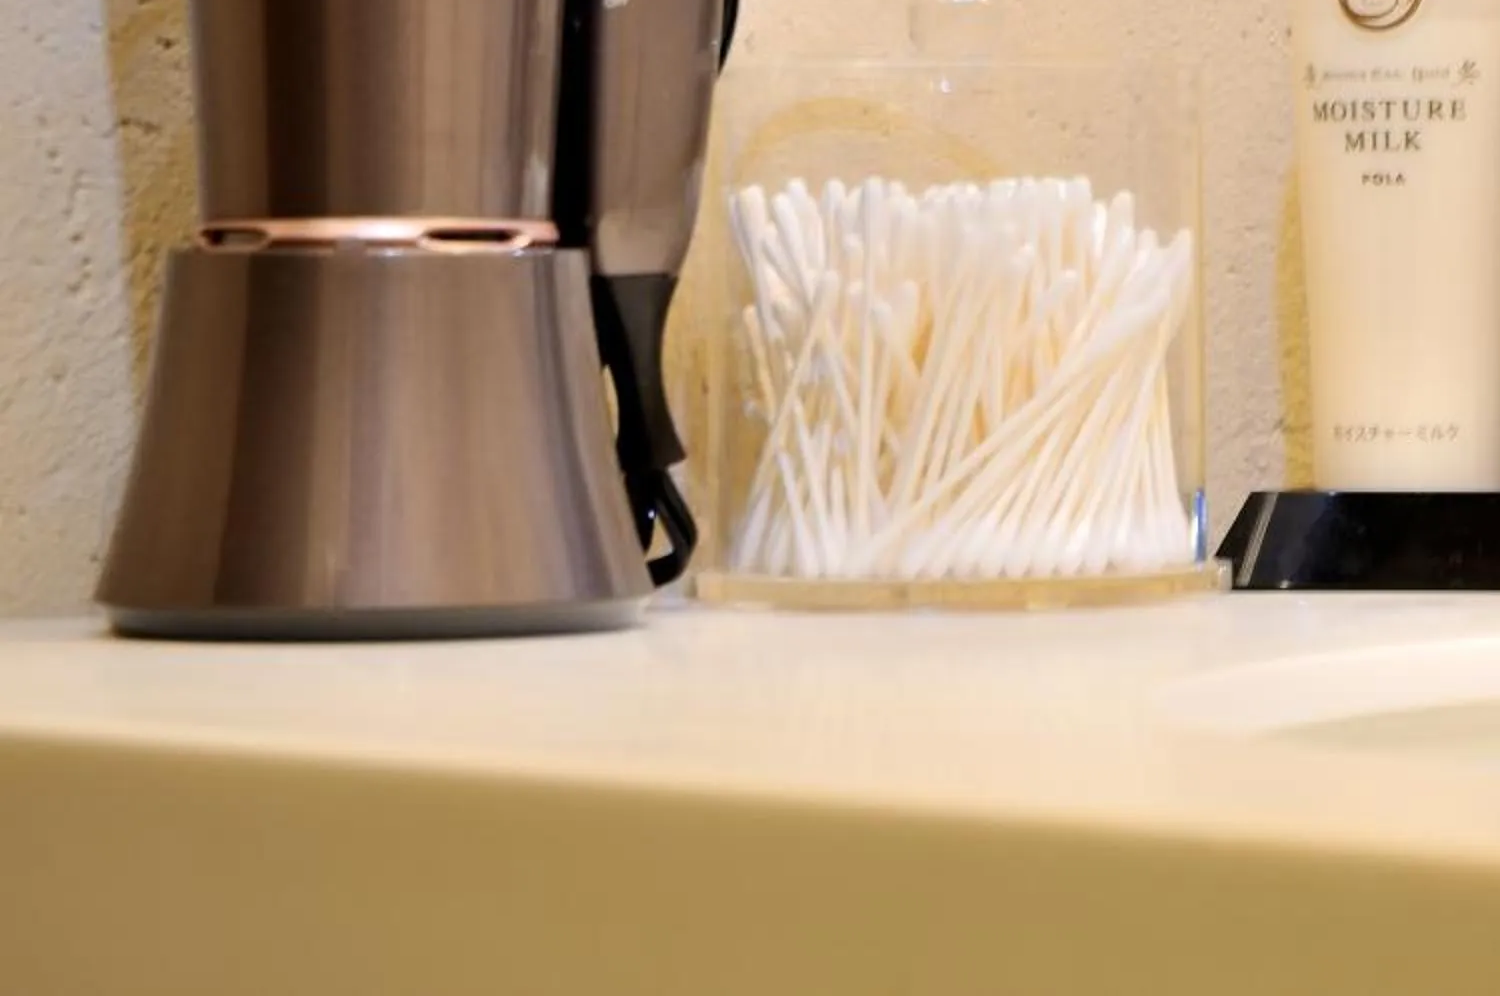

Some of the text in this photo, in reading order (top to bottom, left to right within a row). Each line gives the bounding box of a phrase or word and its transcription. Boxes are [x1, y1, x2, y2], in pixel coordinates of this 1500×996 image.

[1312, 99, 1467, 123] MOISTURE
[1344, 129, 1422, 153] MILK
[1361, 172, 1406, 187] POLA
